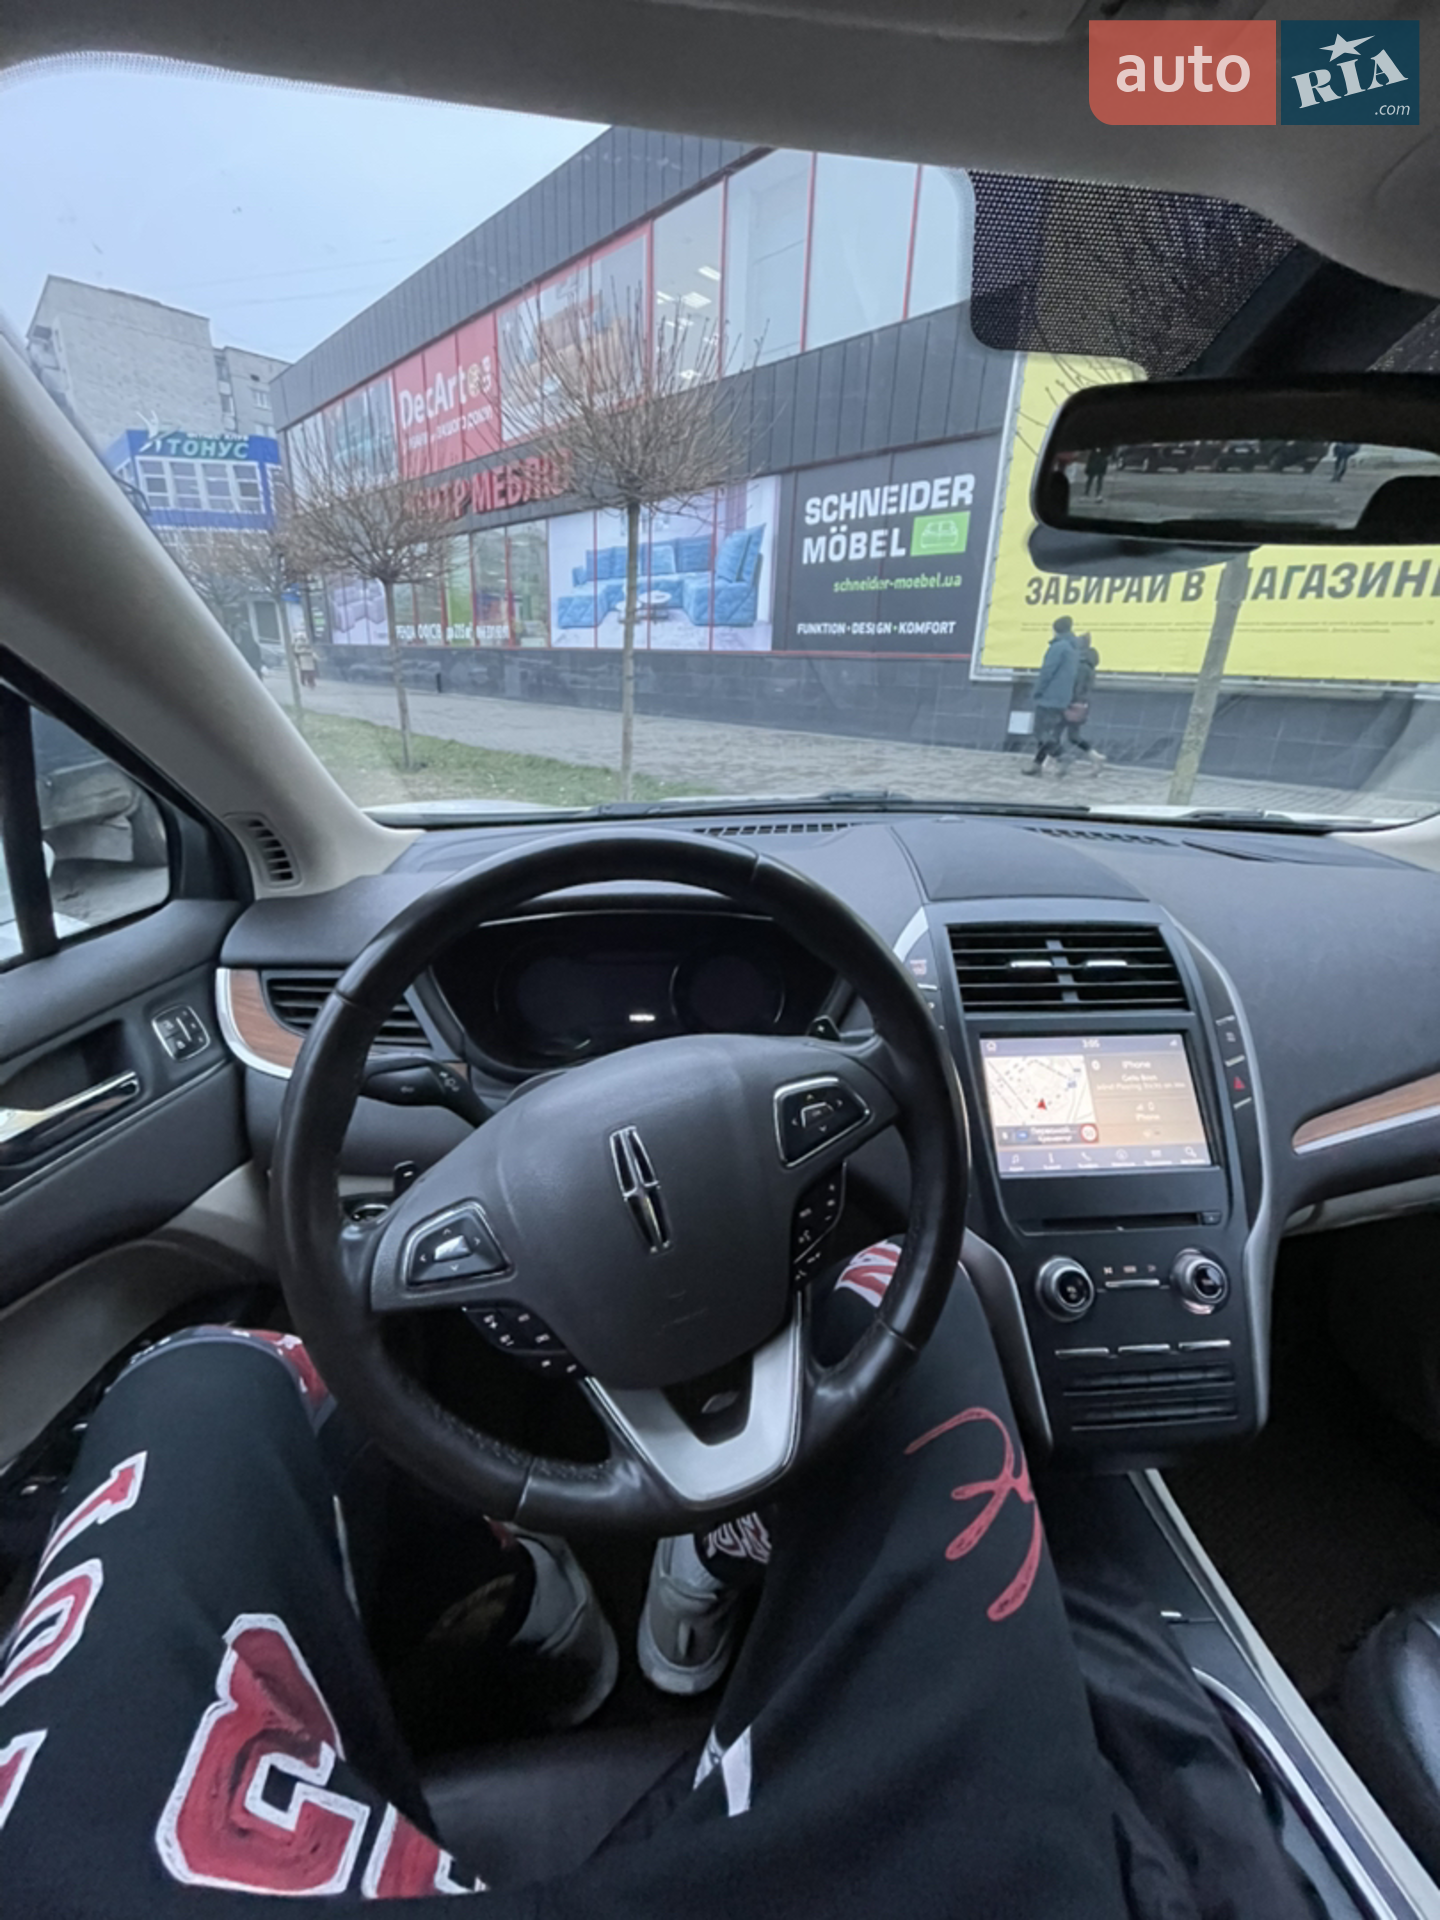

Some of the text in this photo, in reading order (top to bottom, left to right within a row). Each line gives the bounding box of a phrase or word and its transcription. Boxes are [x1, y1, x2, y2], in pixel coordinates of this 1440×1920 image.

[166, 438, 249, 459] ТОНУС
[805, 473, 975, 525] SCHNEIDER
[802, 525, 906, 565] MÖBEL
[833, 572, 962, 592] schneider-moebel.ua
[1181, 570, 1206, 602] В
[1215, 558, 1440, 602] АГАЗИН
[796, 621, 957, 635] FUNKTION DESIGN KOMFORT
